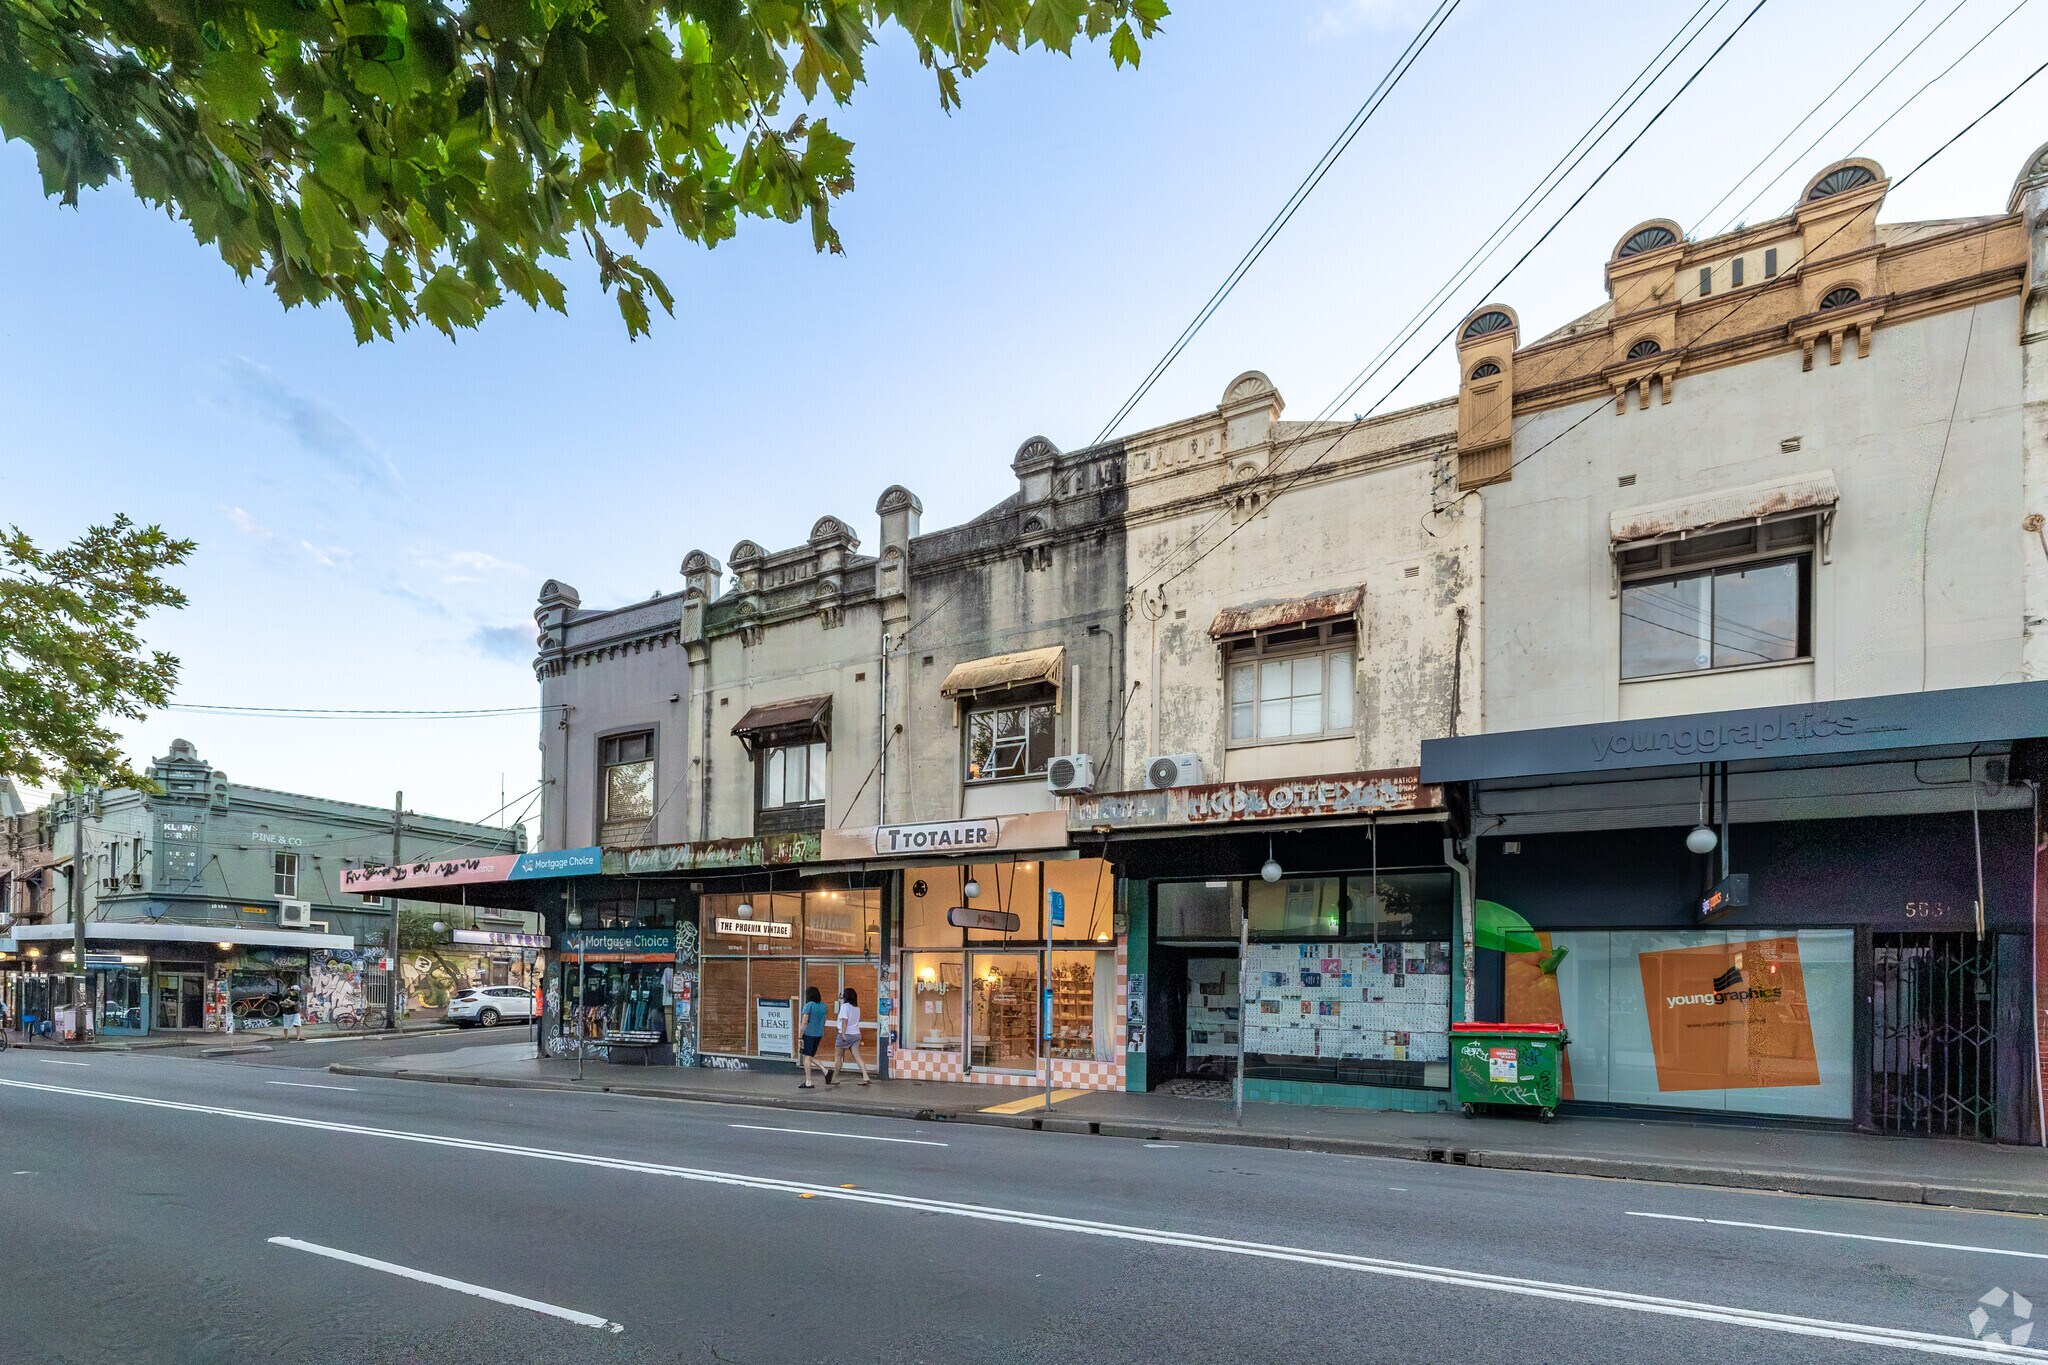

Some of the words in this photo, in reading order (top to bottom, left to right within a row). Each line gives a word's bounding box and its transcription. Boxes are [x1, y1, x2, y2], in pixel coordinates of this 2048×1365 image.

[252, 832, 277, 843] PINE
[278, 836, 286, 845] &
[288, 837, 302, 846] CO
[535, 859, 568, 870] Mortgage
[569, 856, 594, 866] Choice
[720, 921, 733, 931] THE
[735, 923, 762, 934] PHOENIX
[763, 925, 788, 935] VINTAGE
[585, 935, 632, 950] Mortgage
[634, 934, 669, 947] Choice
[1666, 987, 1782, 1009] younggraphics
[760, 1019, 789, 1029] LEASE
